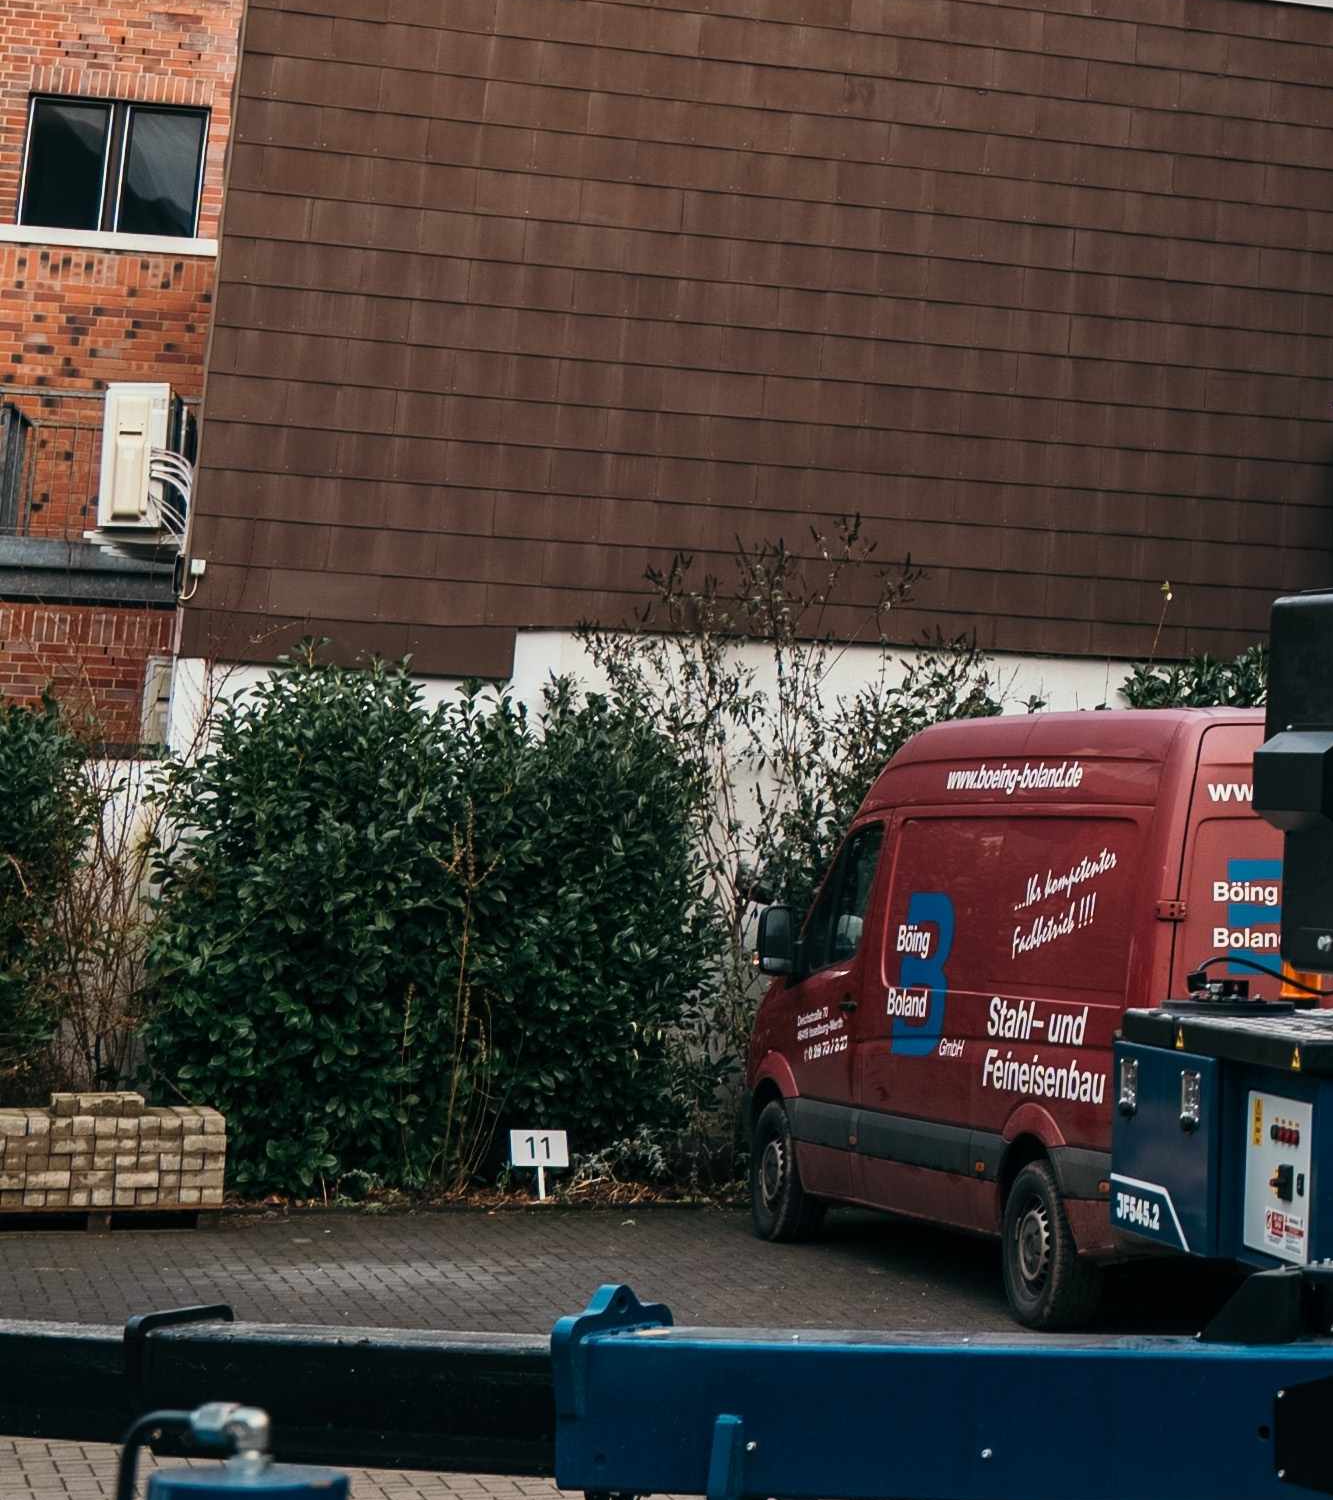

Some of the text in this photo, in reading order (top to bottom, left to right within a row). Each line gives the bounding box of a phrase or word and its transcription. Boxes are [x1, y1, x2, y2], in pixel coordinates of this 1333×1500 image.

[946, 761, 1083, 795] www.boeing-boland.de
[1044, 848, 1117, 899] kompetenter
[1212, 881, 1278, 907] Böing
[896, 924, 931, 959] Böing
[1011, 902, 1075, 961] Fachbetrieb
[1212, 927, 1281, 949] Bolan
[886, 987, 928, 1018] Boland
[987, 996, 1089, 1046] Stahl- und
[938, 1037, 966, 1058] GmbH
[982, 1047, 1106, 1104] Feineisenbau
[525, 1136, 551, 1159] 11
[1116, 1192, 1160, 1231] JF545.2
